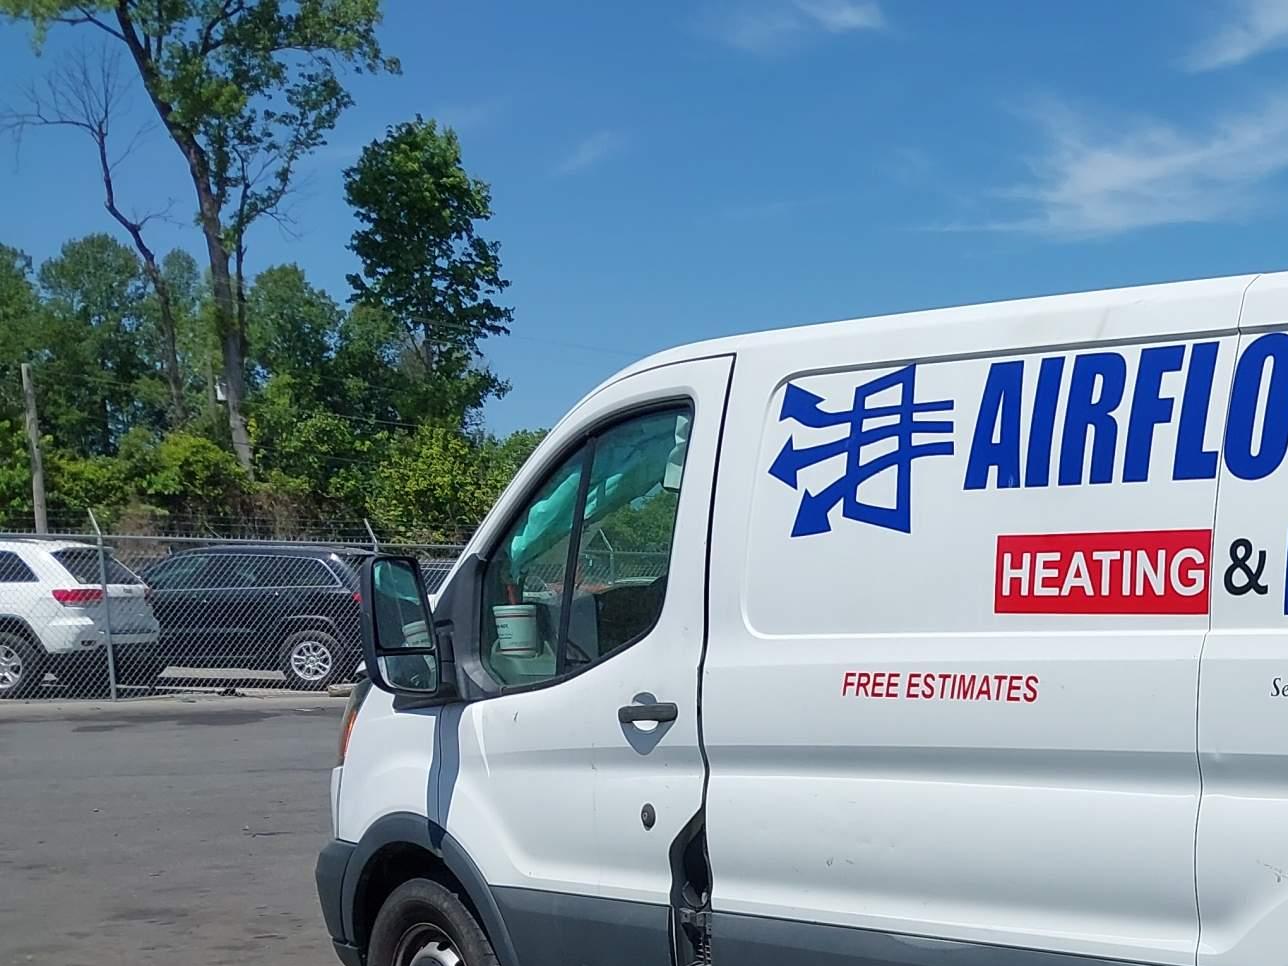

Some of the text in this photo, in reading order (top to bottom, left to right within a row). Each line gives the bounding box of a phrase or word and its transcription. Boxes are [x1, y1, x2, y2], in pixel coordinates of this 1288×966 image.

[1001, 548, 1206, 598] HEATING
[1222, 538, 1269, 596] &
[842, 672, 1040, 703] FREE ESTIMATES
